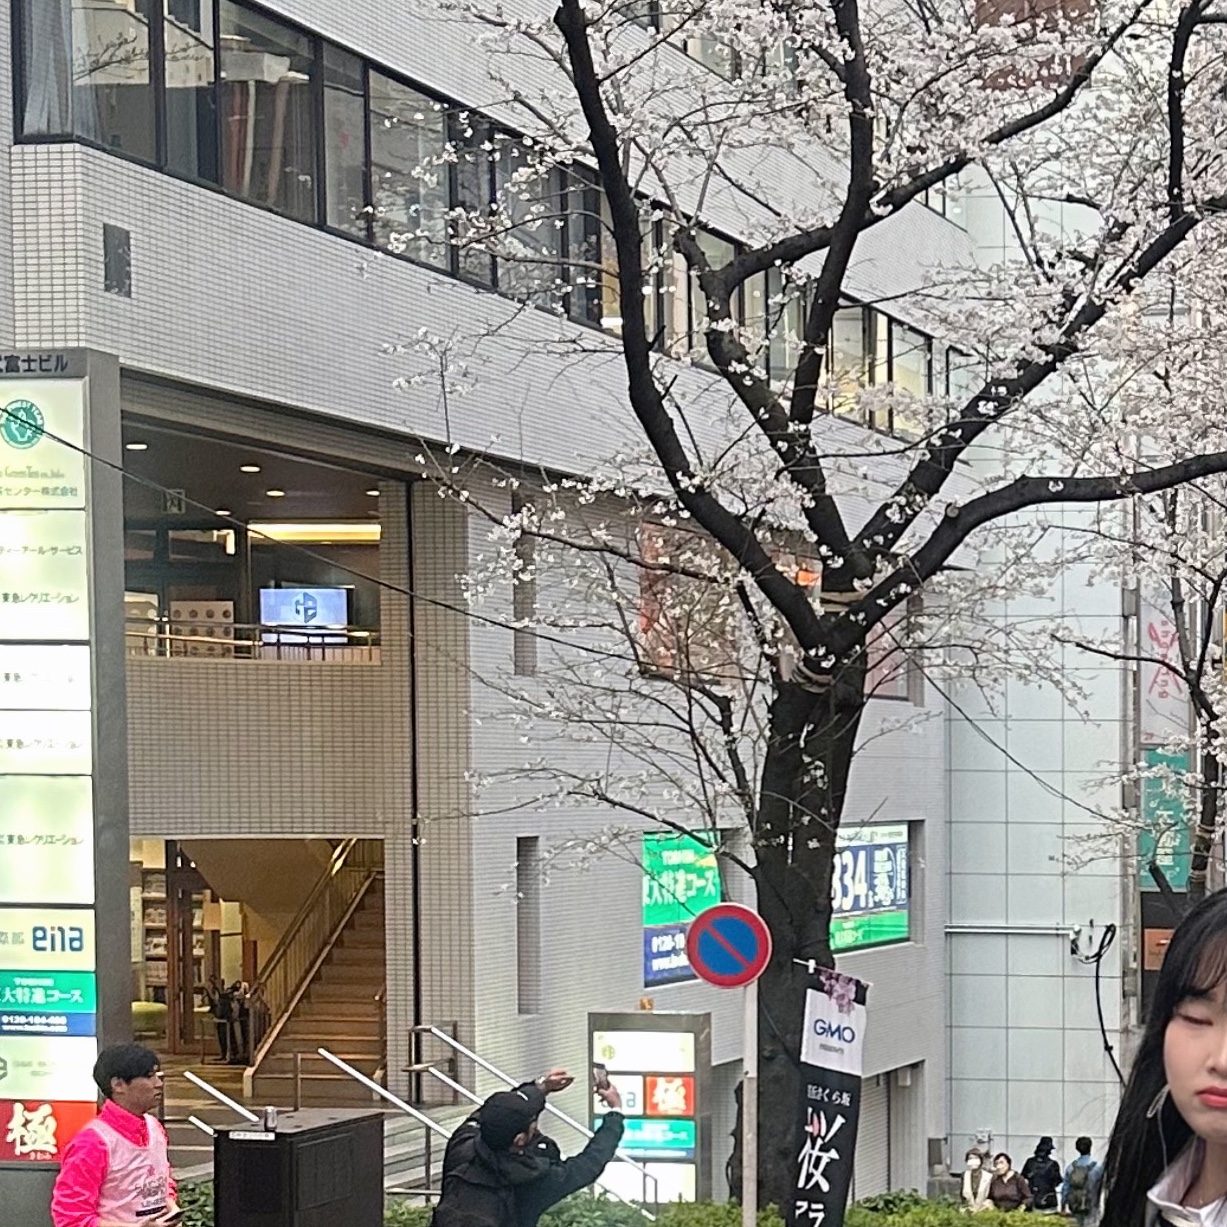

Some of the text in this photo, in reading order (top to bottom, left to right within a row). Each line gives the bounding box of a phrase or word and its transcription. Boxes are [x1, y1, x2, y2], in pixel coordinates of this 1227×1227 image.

[0, 354, 69, 373] 富士ビル
[0, 486, 78, 497] センター株式会社
[0, 987, 84, 1004] 大特進コース
[814, 1018, 855, 1043] GMO
[6, 1102, 58, 1156] 極
